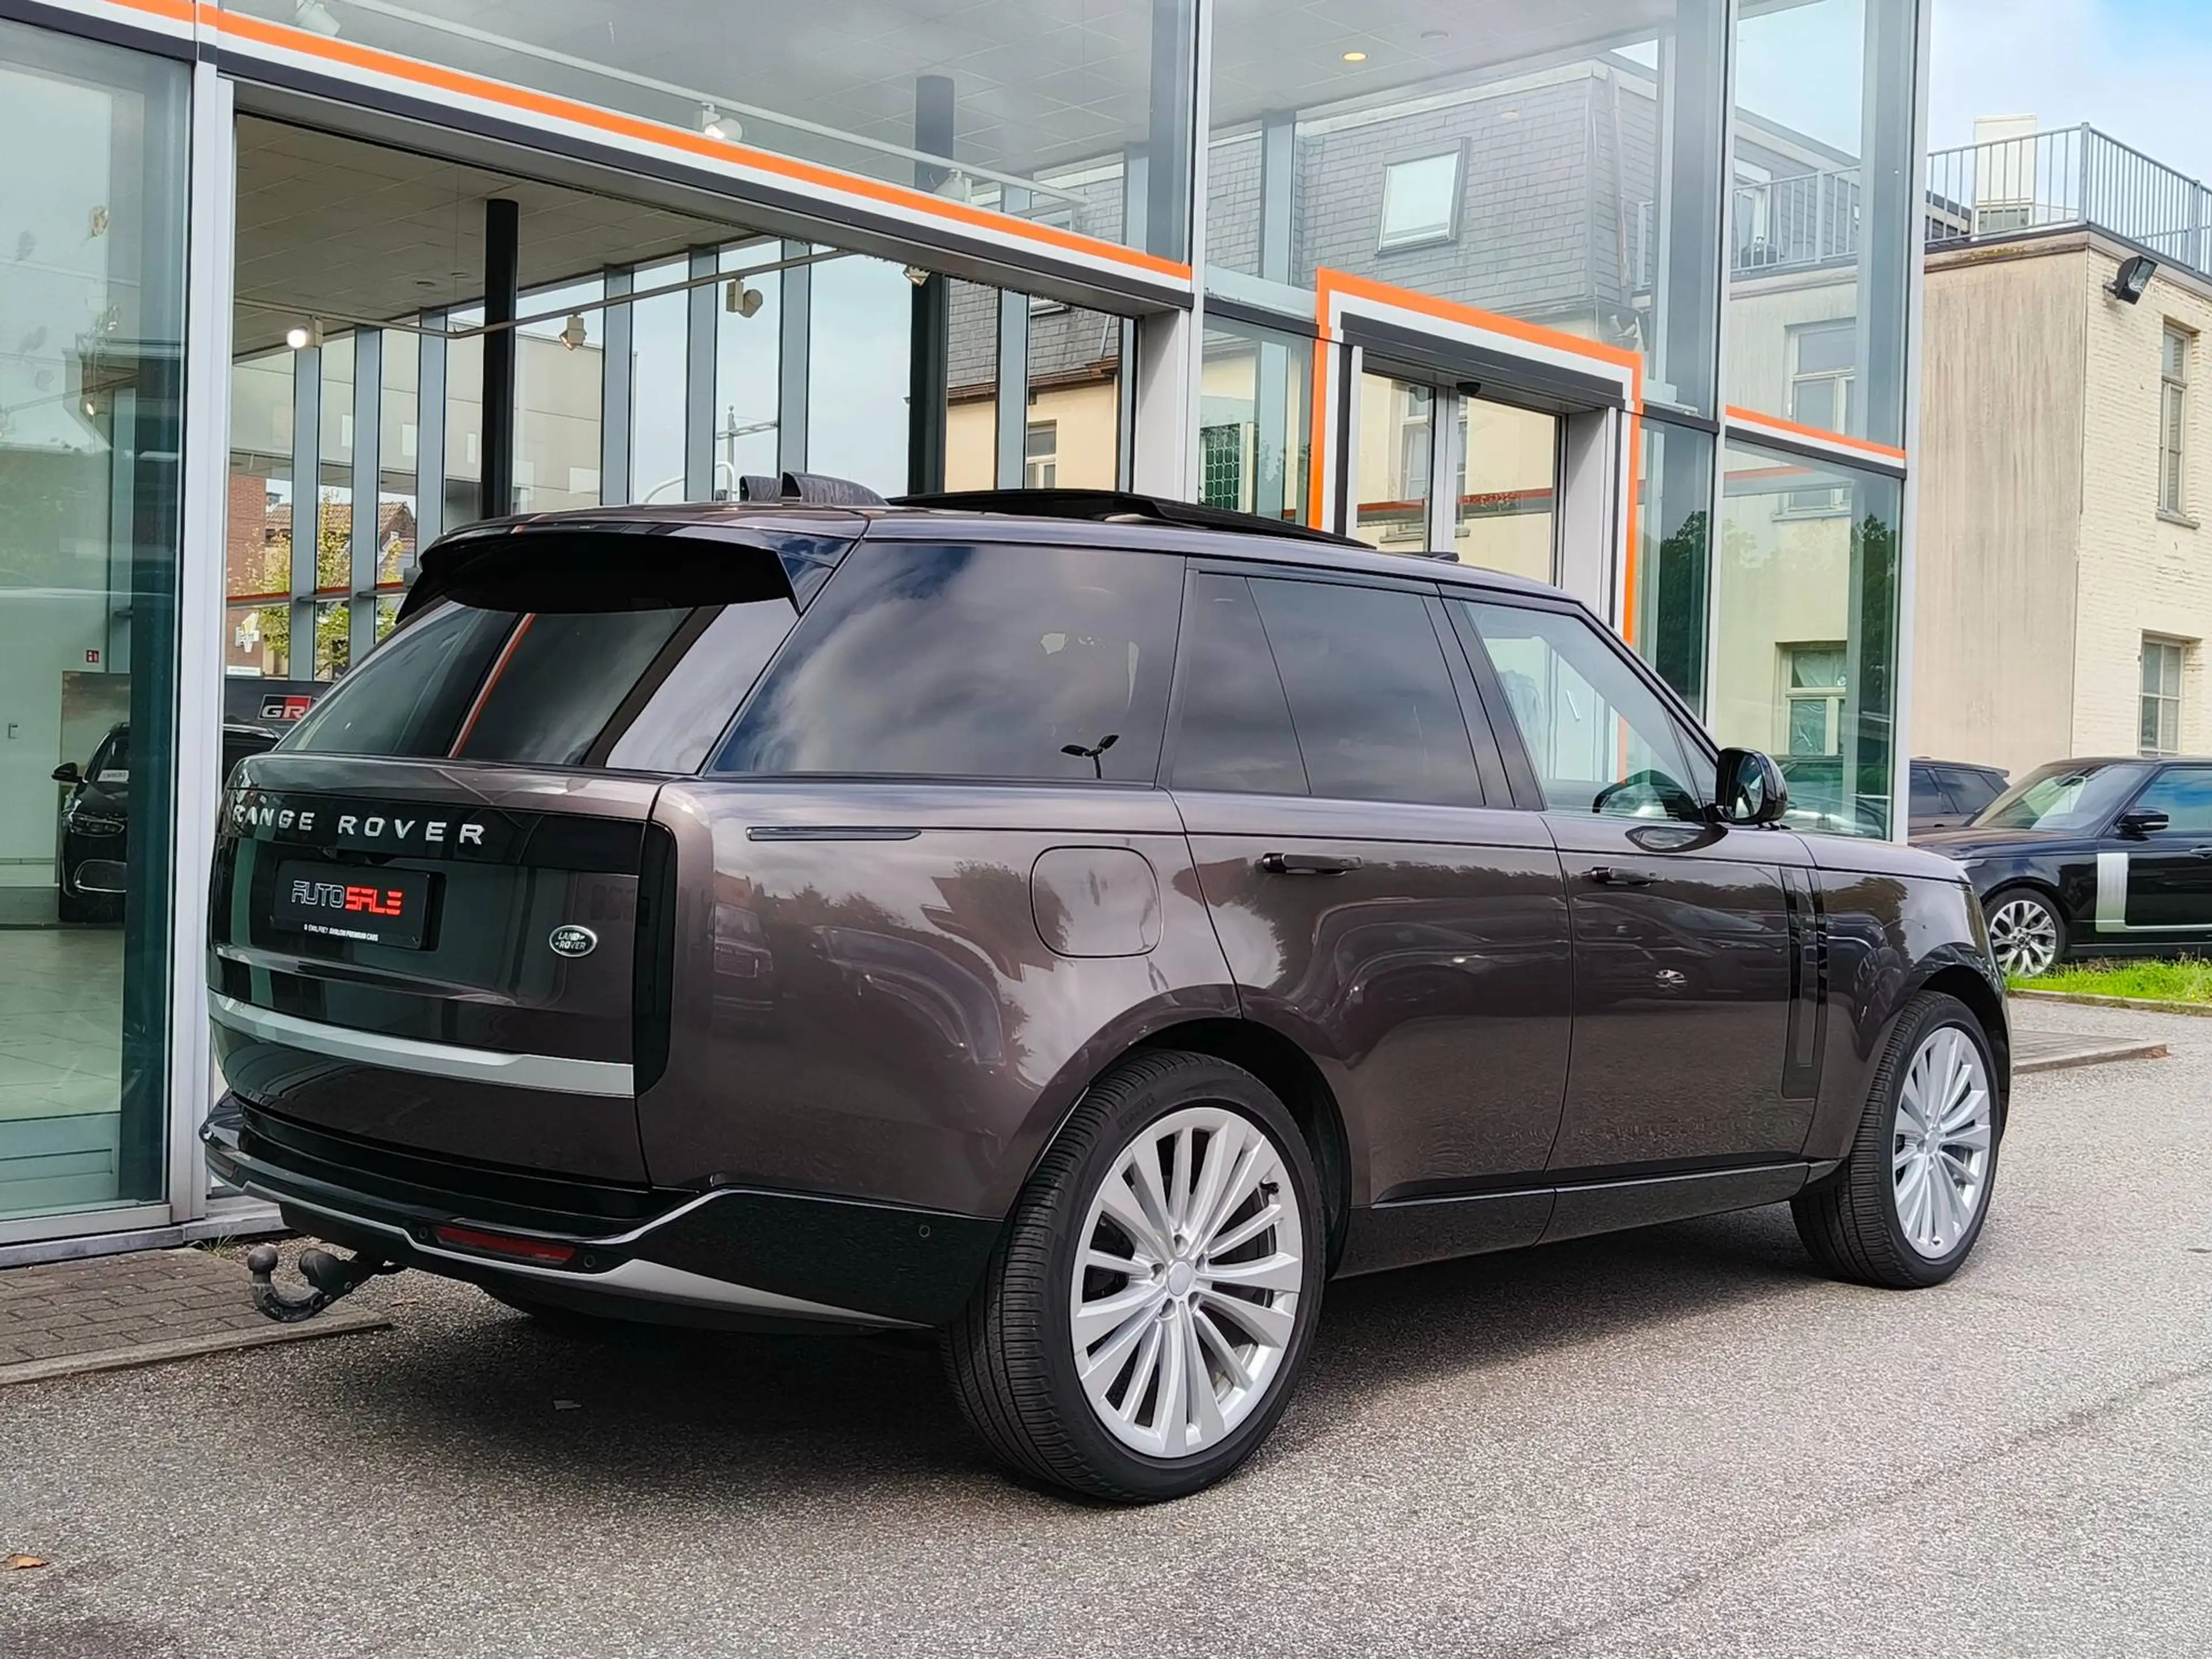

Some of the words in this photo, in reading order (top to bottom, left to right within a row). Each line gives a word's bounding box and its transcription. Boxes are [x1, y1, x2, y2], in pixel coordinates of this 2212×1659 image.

[262, 704, 306, 719] GR
[233, 804, 315, 831] RANGE
[338, 815, 485, 845] ROVER
[559, 941, 586, 950] ROVER
